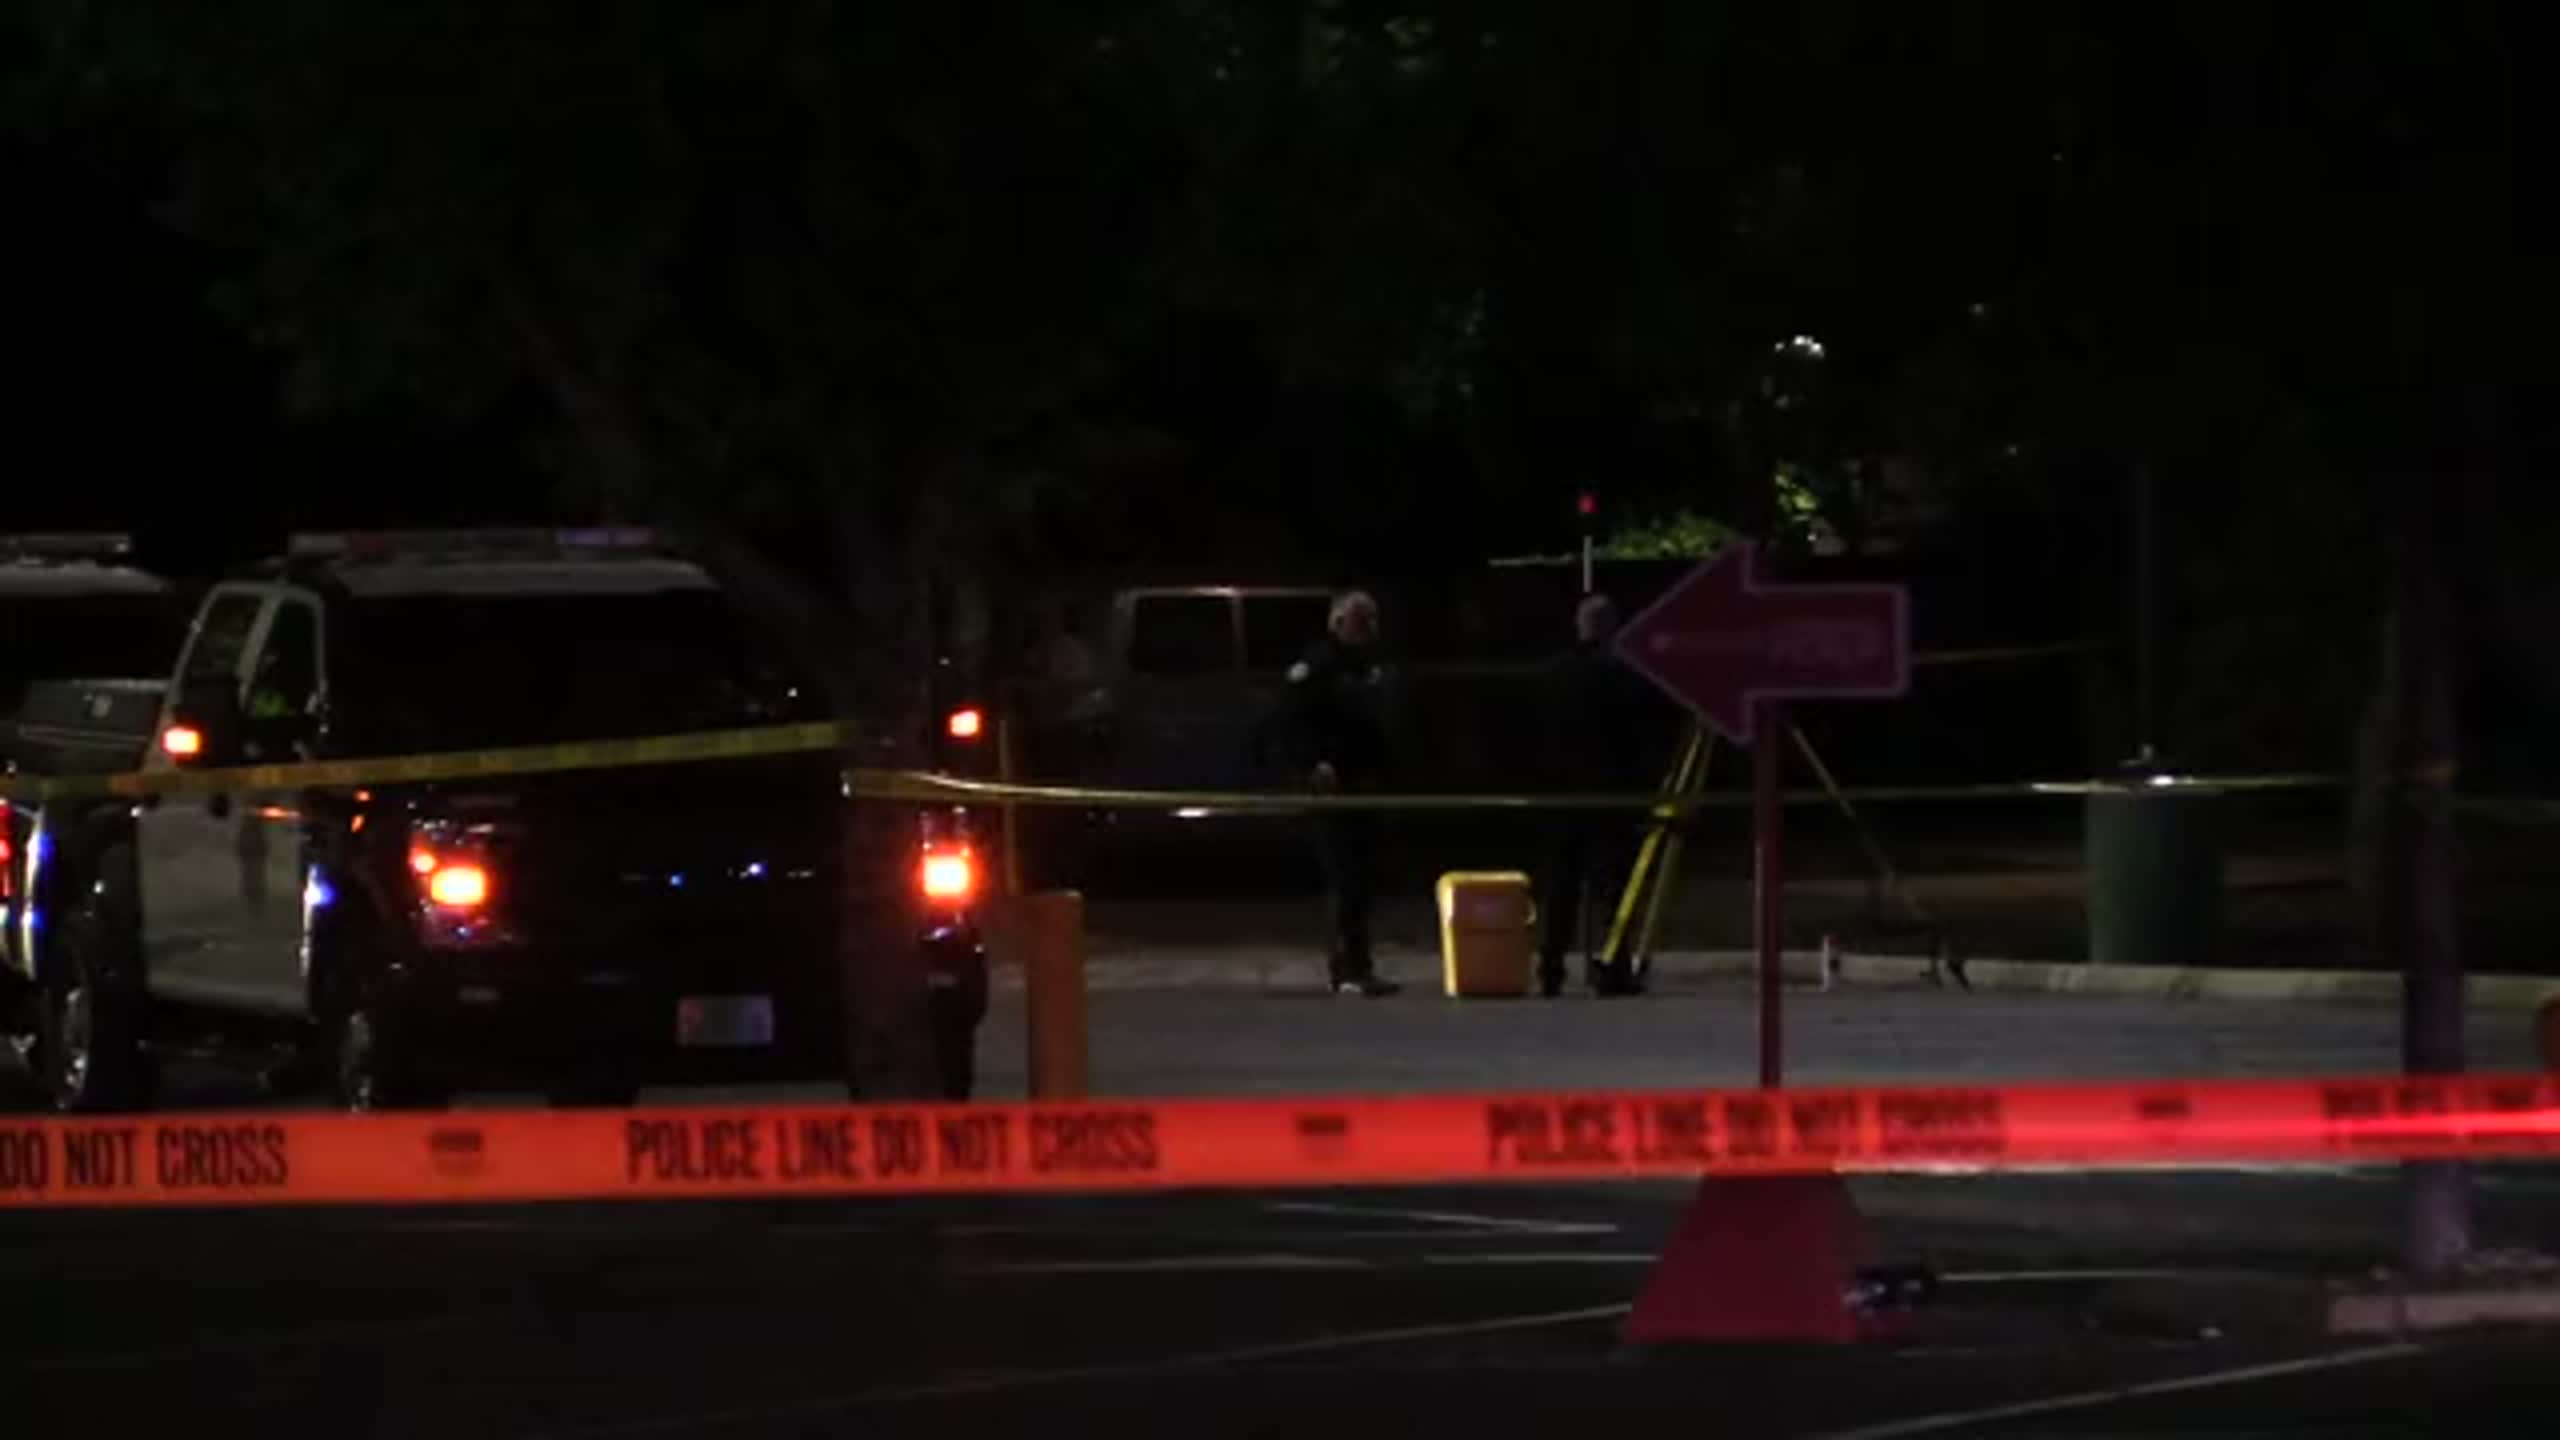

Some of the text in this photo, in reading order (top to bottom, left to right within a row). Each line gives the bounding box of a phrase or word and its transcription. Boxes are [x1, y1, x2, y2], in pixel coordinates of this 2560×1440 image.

[64, 1128, 139, 1188] NOT
[155, 1123, 288, 1187] CROSS
[625, 1112, 1157, 1182] POLICE LINE DO NOT CROSS
[1486, 1101, 1618, 1164] POLICE
